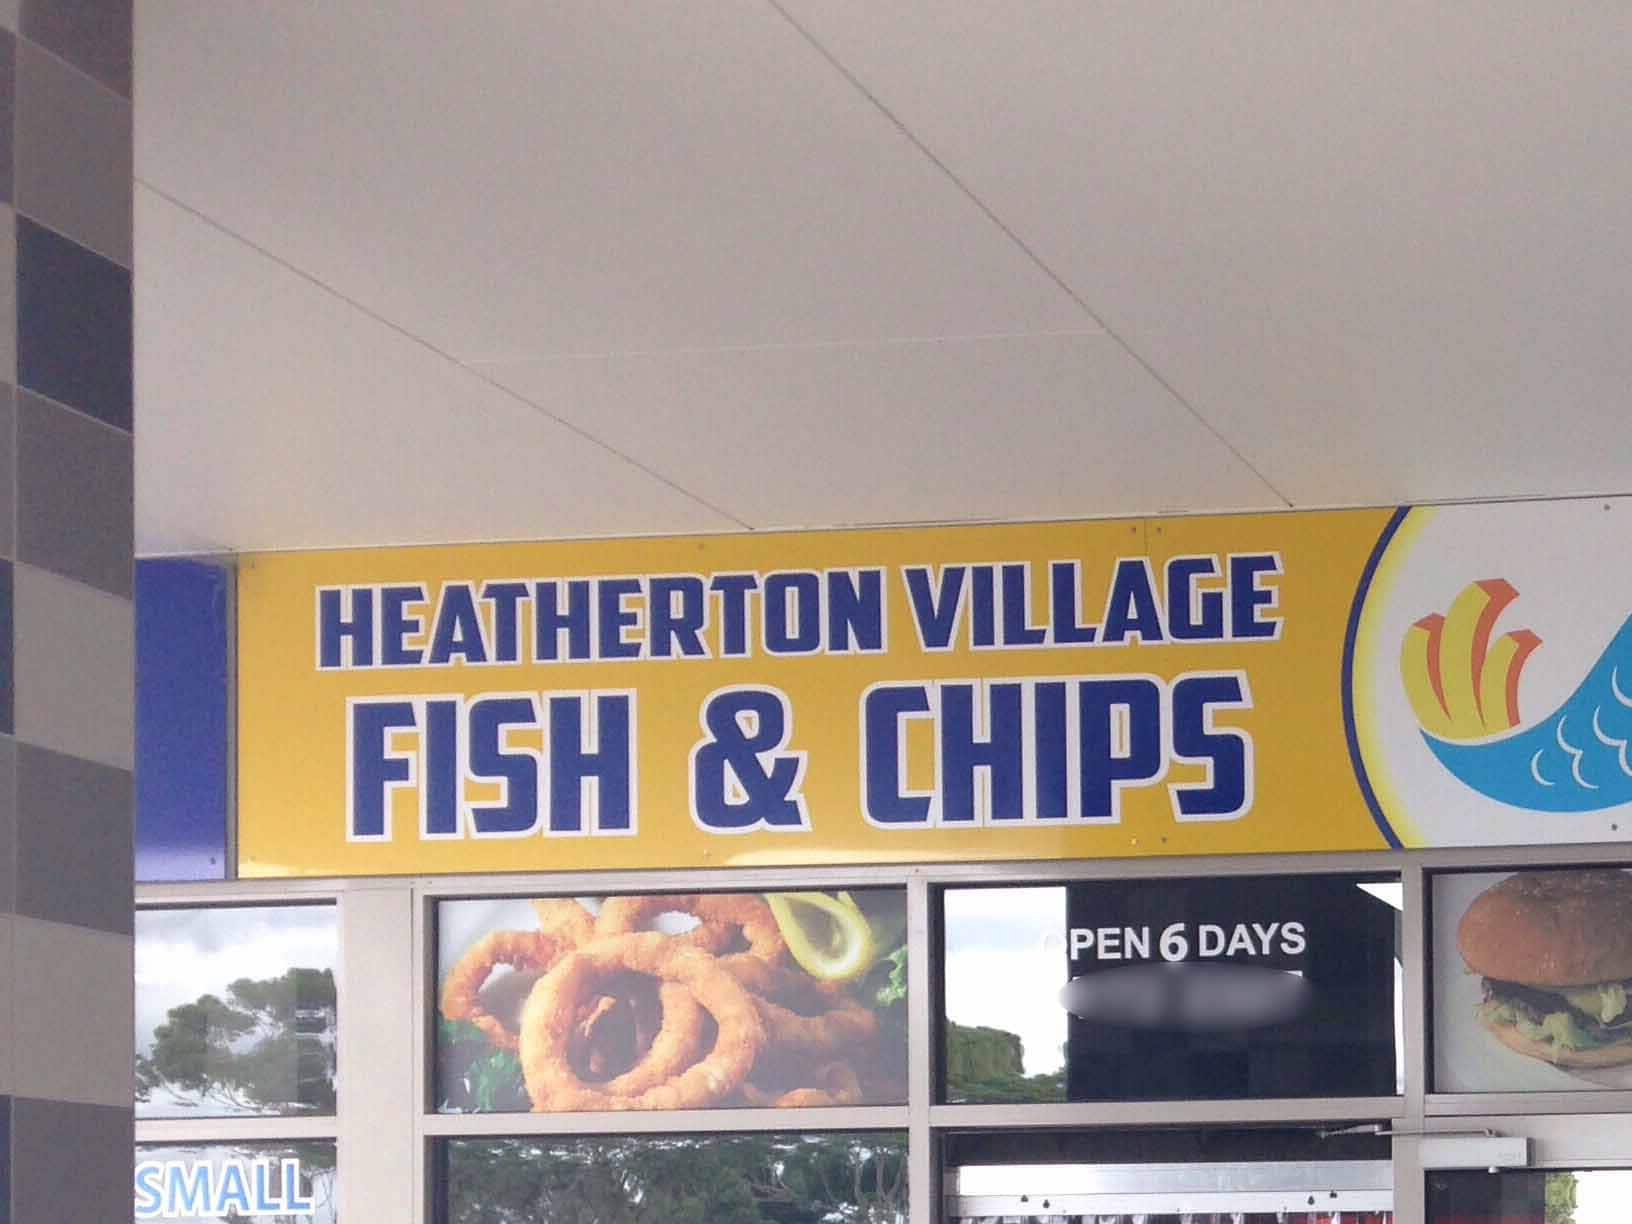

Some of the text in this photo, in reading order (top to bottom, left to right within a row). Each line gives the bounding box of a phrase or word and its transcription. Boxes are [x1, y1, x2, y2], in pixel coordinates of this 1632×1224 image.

[317, 553, 1281, 669] HEATHERTON VILLAGE
[350, 672, 1250, 839] FISH & CHIPS
[1159, 922, 1188, 961] 6
[1198, 921, 1306, 958] DAYS
[135, 1161, 313, 1216] SMALL
